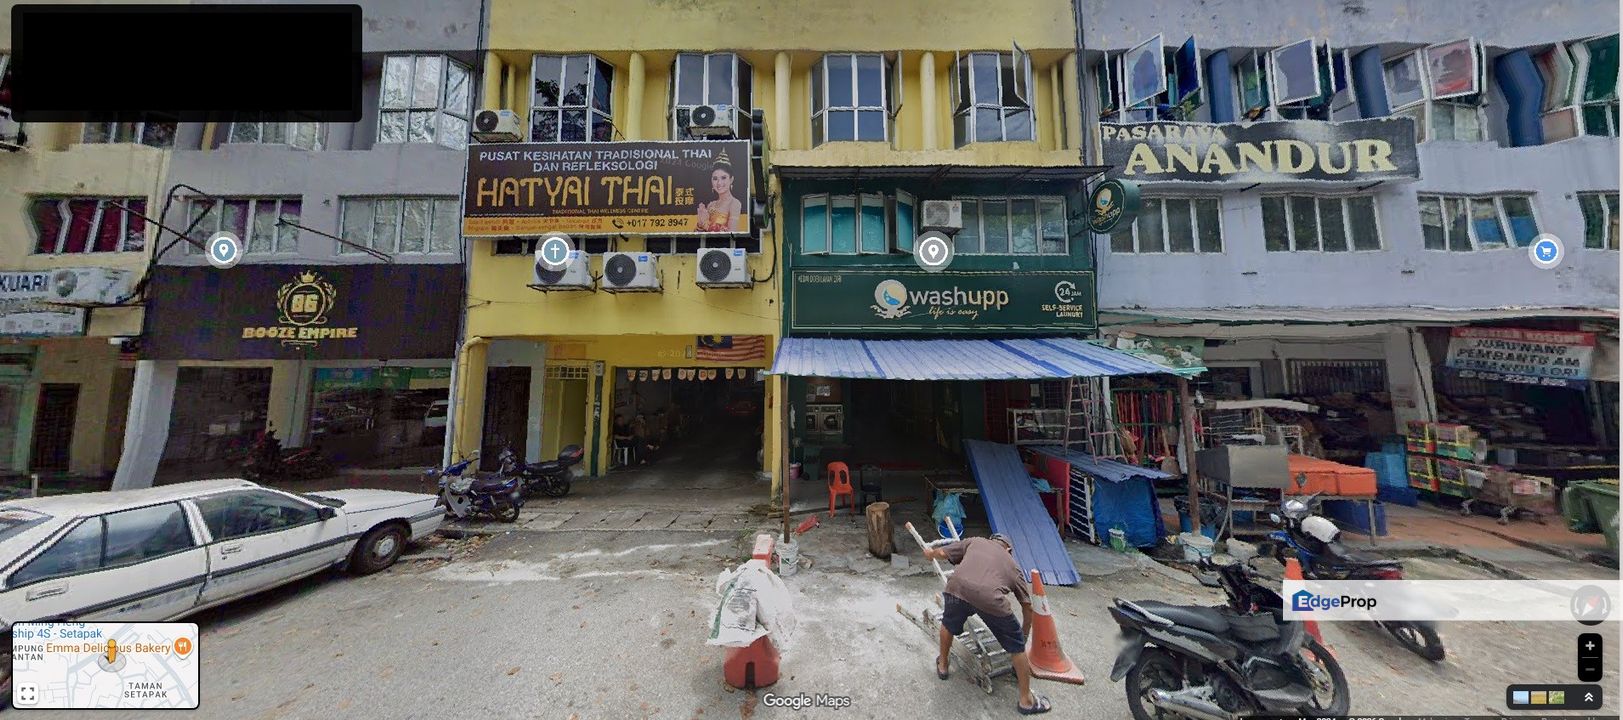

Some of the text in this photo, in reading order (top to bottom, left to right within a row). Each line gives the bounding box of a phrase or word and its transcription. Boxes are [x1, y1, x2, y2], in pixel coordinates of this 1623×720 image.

[479, 148, 712, 162] PUSAT KESIHATAN TRADISIONAL THAI
[1124, 139, 1399, 175] ANANDUR
[533, 160, 658, 173] DAN REFLEKSOLOGI
[476, 174, 673, 207] HATYAI THAI
[627, 217, 689, 228] +017 792 8947
[909, 286, 1009, 310] washupp
[1059, 288, 1071, 296] 24
[928, 305, 980, 320] life is easy
[242, 327, 358, 339] BOOZE EMPIRE
